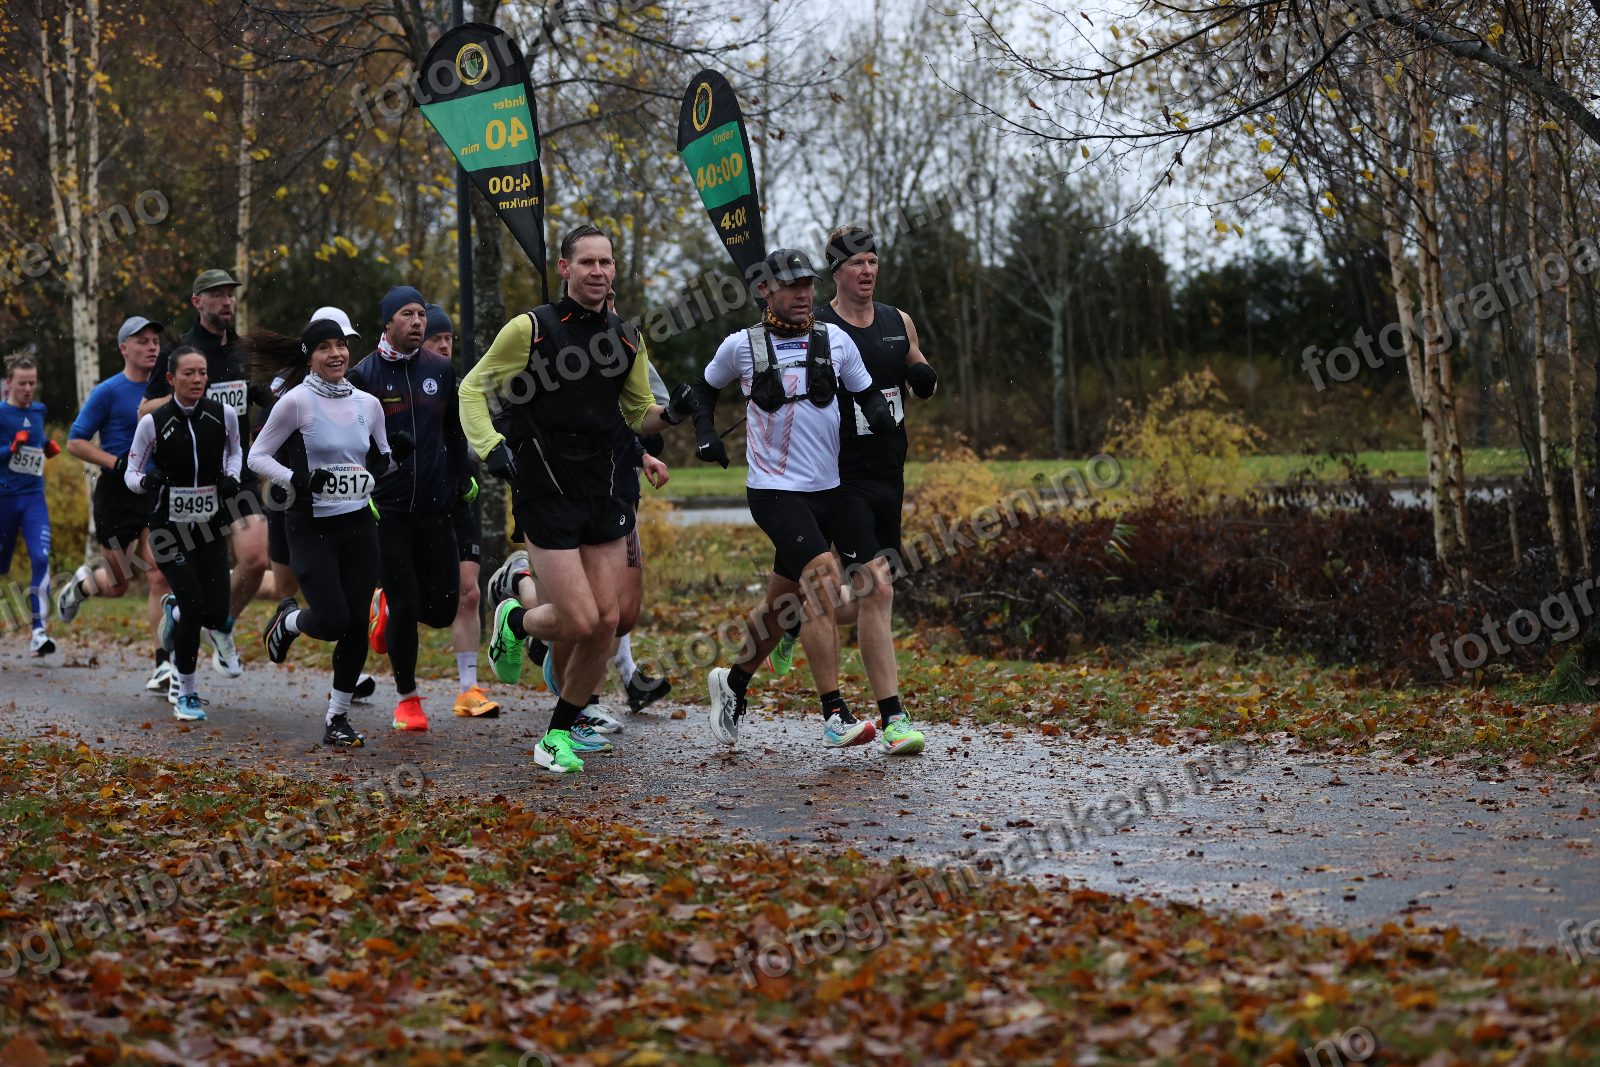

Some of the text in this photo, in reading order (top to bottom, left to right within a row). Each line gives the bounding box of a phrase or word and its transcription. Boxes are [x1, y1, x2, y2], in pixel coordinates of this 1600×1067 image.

[712, 128, 734, 146] Under
[696, 152, 743, 192] 40:00
[13, 452, 42, 468] 9514
[326, 474, 370, 494] 9517
[174, 495, 214, 513] 9495
